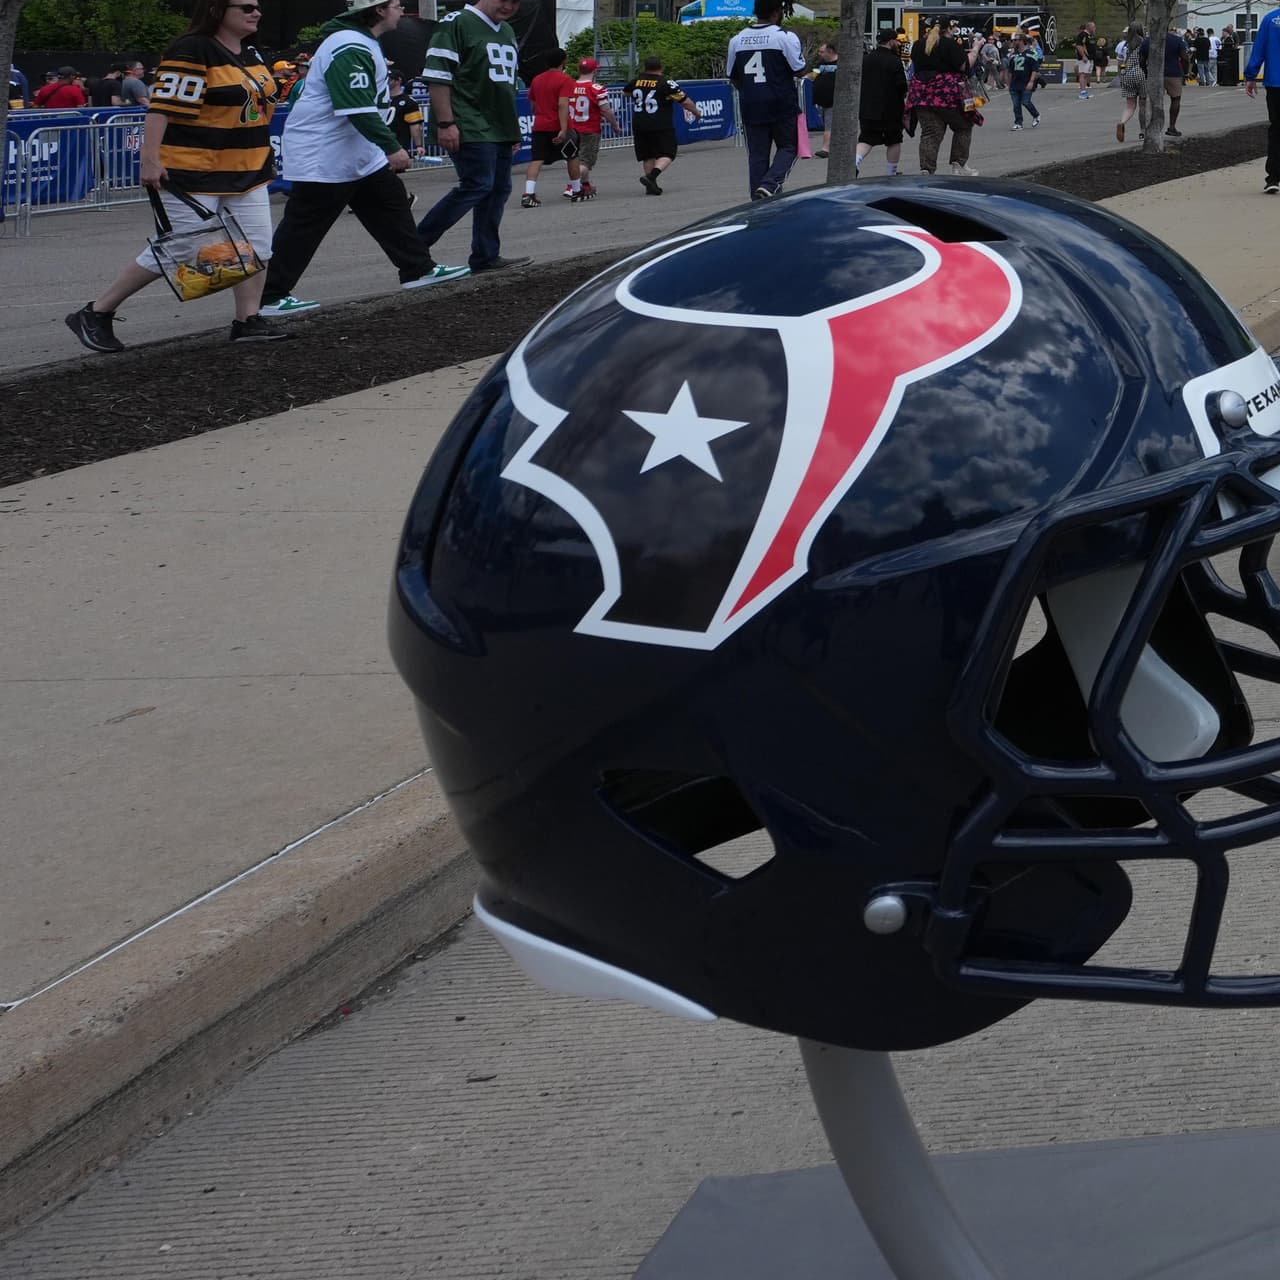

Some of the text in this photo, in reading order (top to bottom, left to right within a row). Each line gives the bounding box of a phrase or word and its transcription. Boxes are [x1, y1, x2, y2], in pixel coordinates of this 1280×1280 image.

[740, 35, 770, 45] PRESCOTT
[487, 42, 517, 85] 99
[744, 51, 767, 83] 4
[1014, 57, 1025, 70] 12
[155, 73, 204, 102] 30
[349, 72, 369, 89] 20
[635, 79, 657, 87] BETTIS
[632, 89, 659, 114] 36
[696, 99, 723, 117] SHOP
